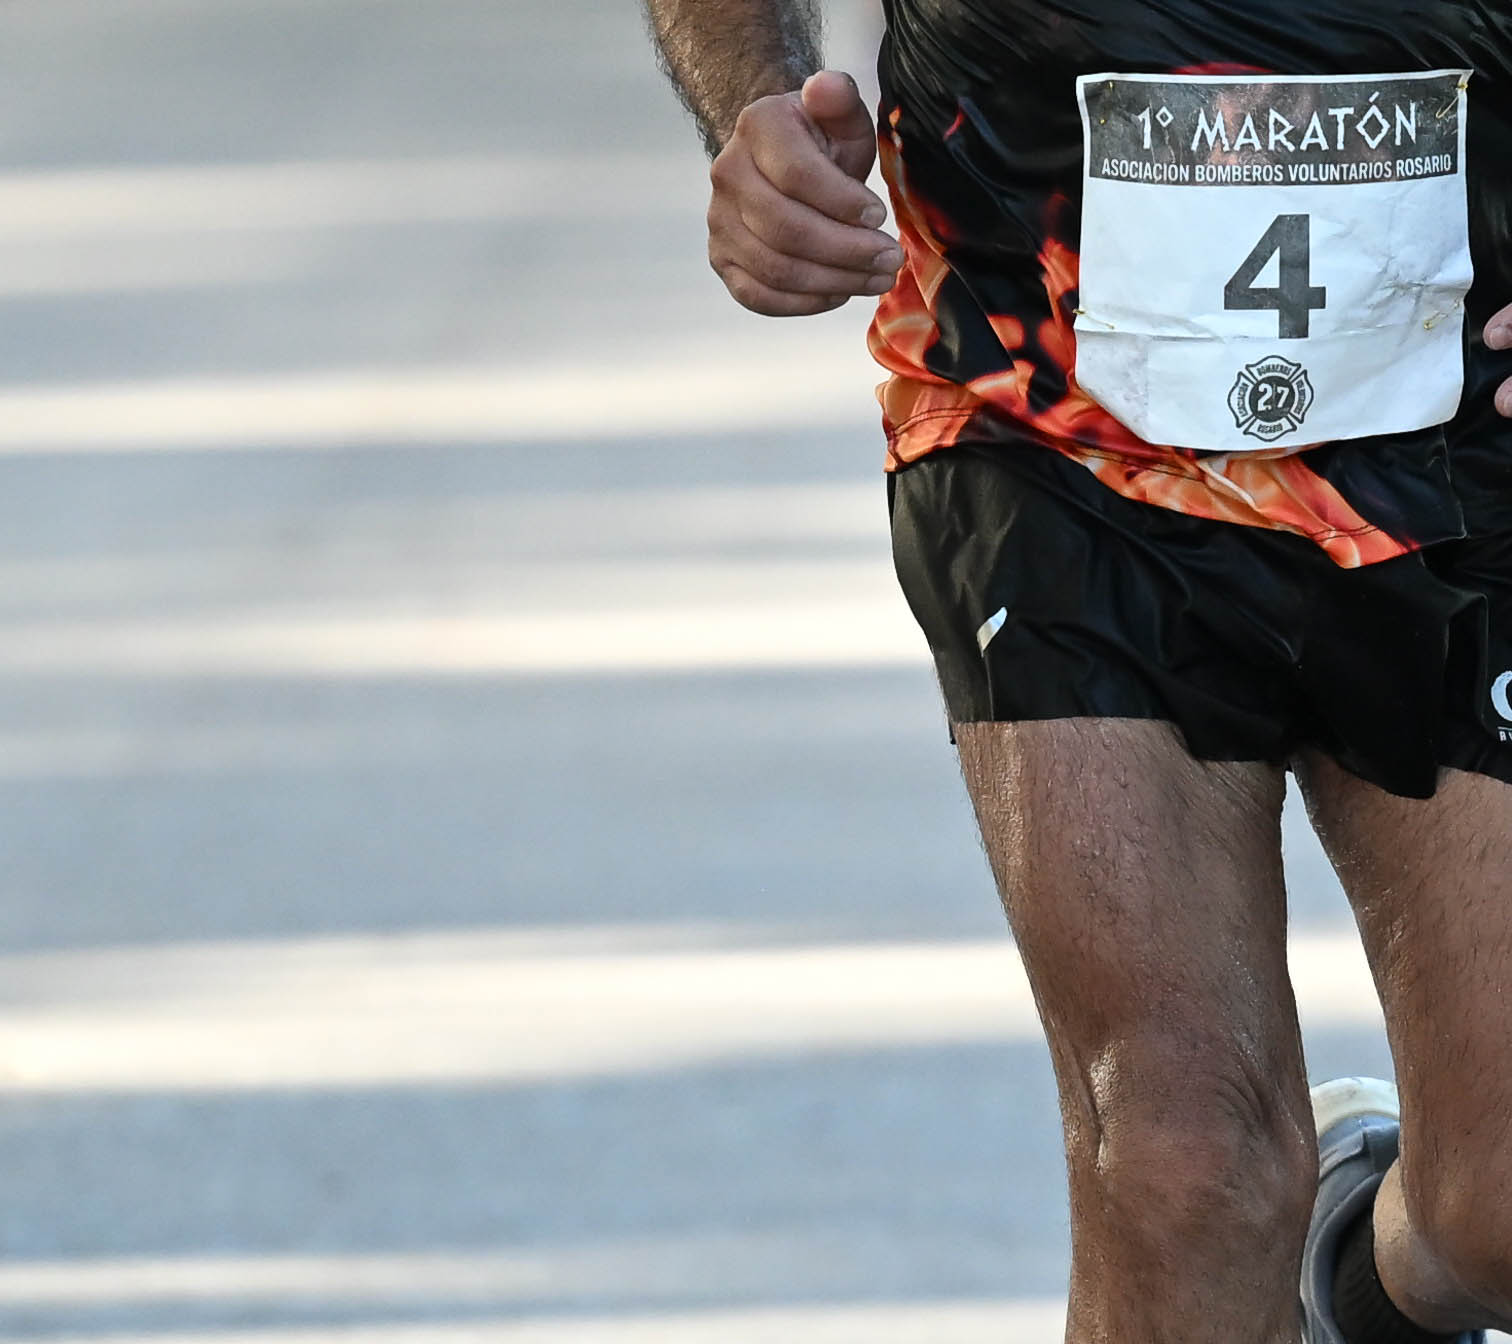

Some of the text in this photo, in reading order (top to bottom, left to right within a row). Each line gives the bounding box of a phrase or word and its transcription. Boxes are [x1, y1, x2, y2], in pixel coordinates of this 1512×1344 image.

[1190, 91, 1417, 153] MARATÓN
[1101, 153, 1453, 184] ASOCIACIÓN BOMBEROS VOLUNTARIOS ROSARIO
[1223, 213, 1327, 340] 4
[1256, 382, 1290, 412] 27
